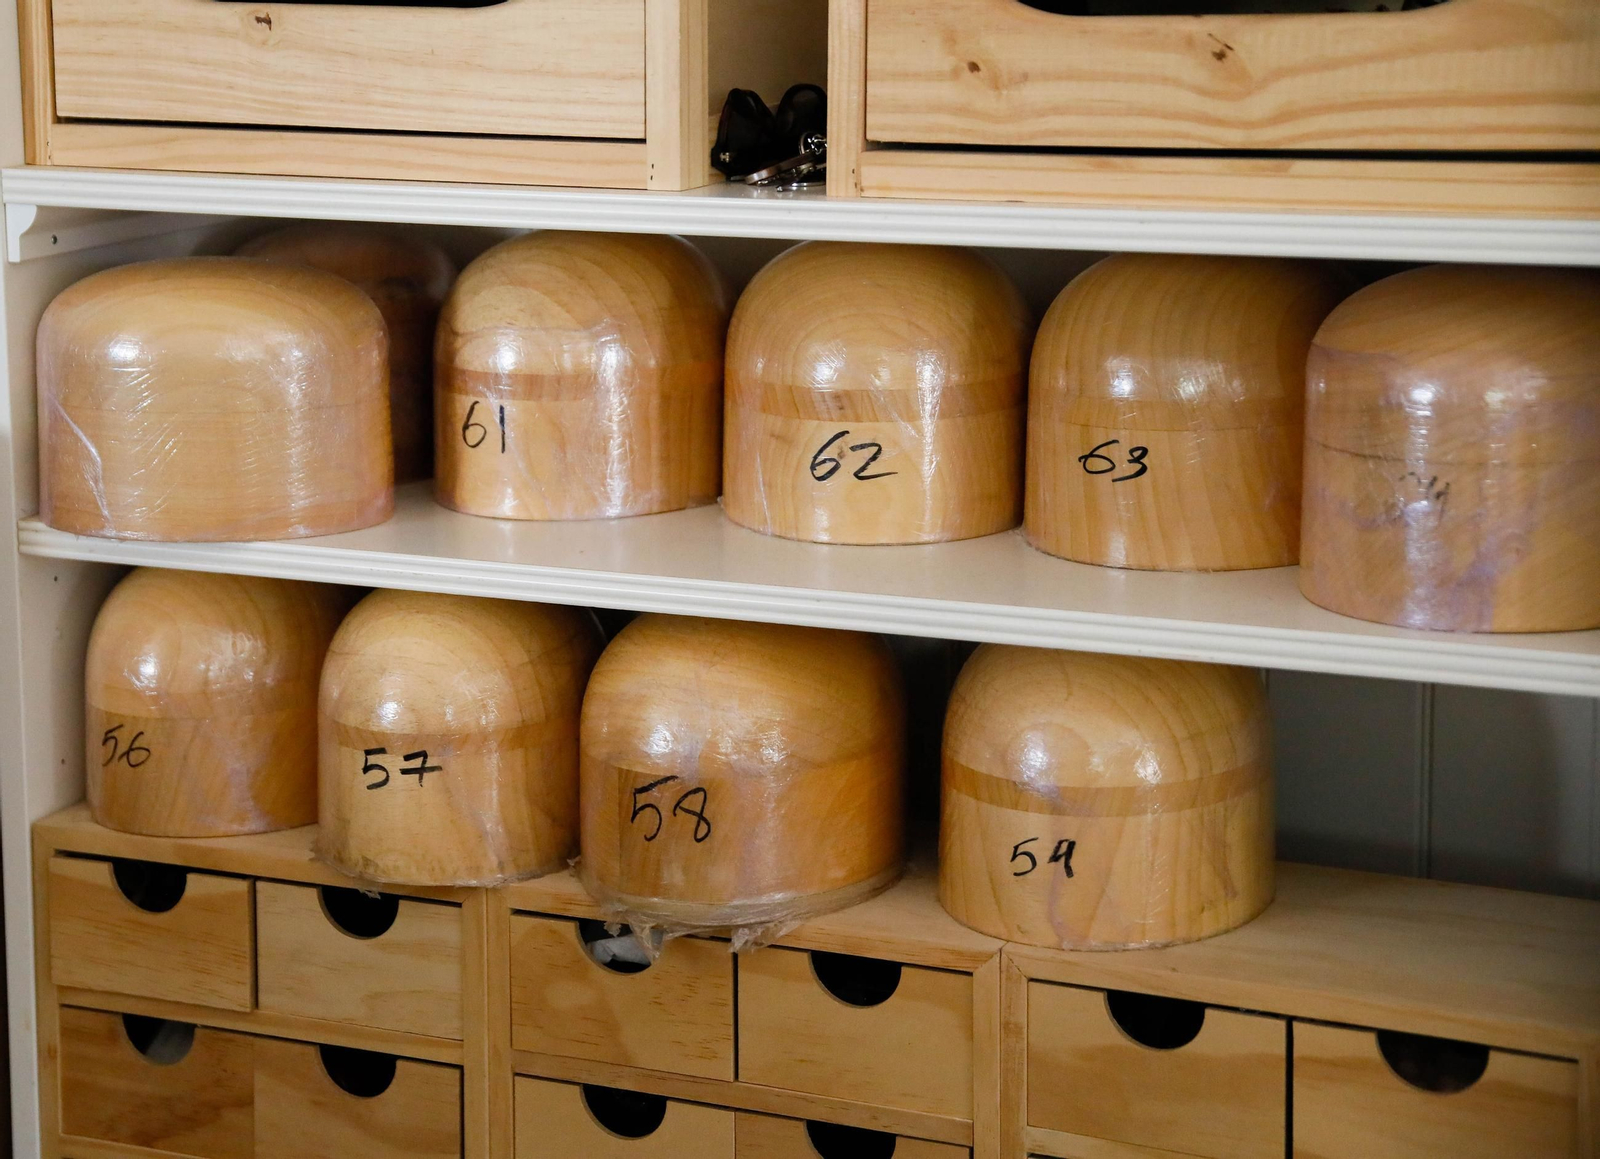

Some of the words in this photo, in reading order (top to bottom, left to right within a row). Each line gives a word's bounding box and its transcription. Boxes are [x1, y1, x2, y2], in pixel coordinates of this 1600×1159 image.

[462, 401, 506, 454] 61
[810, 430, 898, 481] 62
[1078, 440, 1149, 482] 63
[101, 724, 151, 768] 56
[362, 747, 442, 790] 57
[627, 775, 712, 843] 58
[1010, 837, 1077, 879] 59
